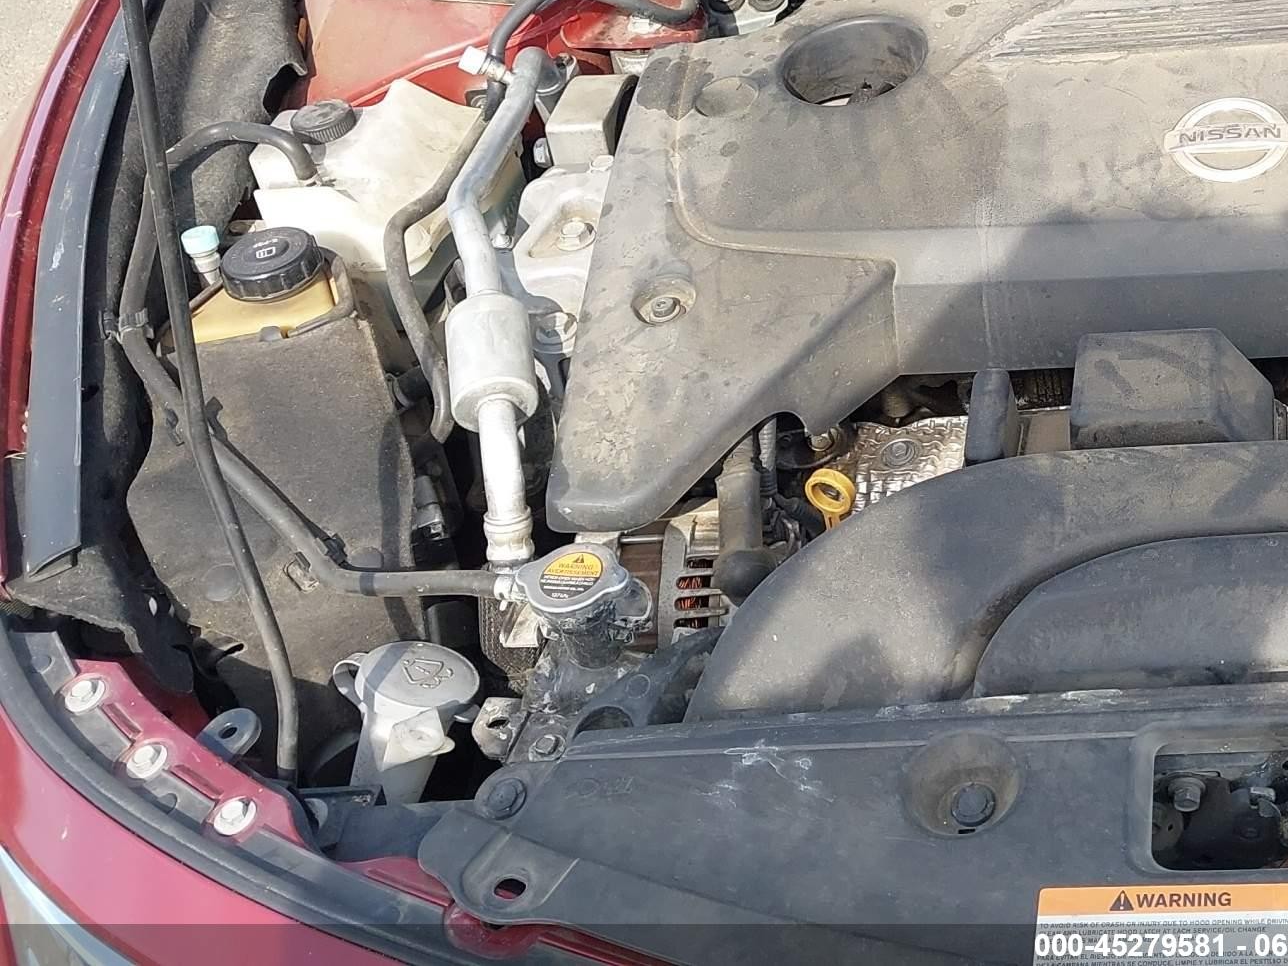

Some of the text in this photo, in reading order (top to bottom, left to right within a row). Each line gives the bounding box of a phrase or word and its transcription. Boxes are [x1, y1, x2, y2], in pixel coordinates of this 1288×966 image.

[1178, 125, 1282, 144] NISSAN
[1136, 892, 1232, 908] WARNING
[1040, 922, 1049, 930] TO
[1072, 921, 1089, 929] RISK
